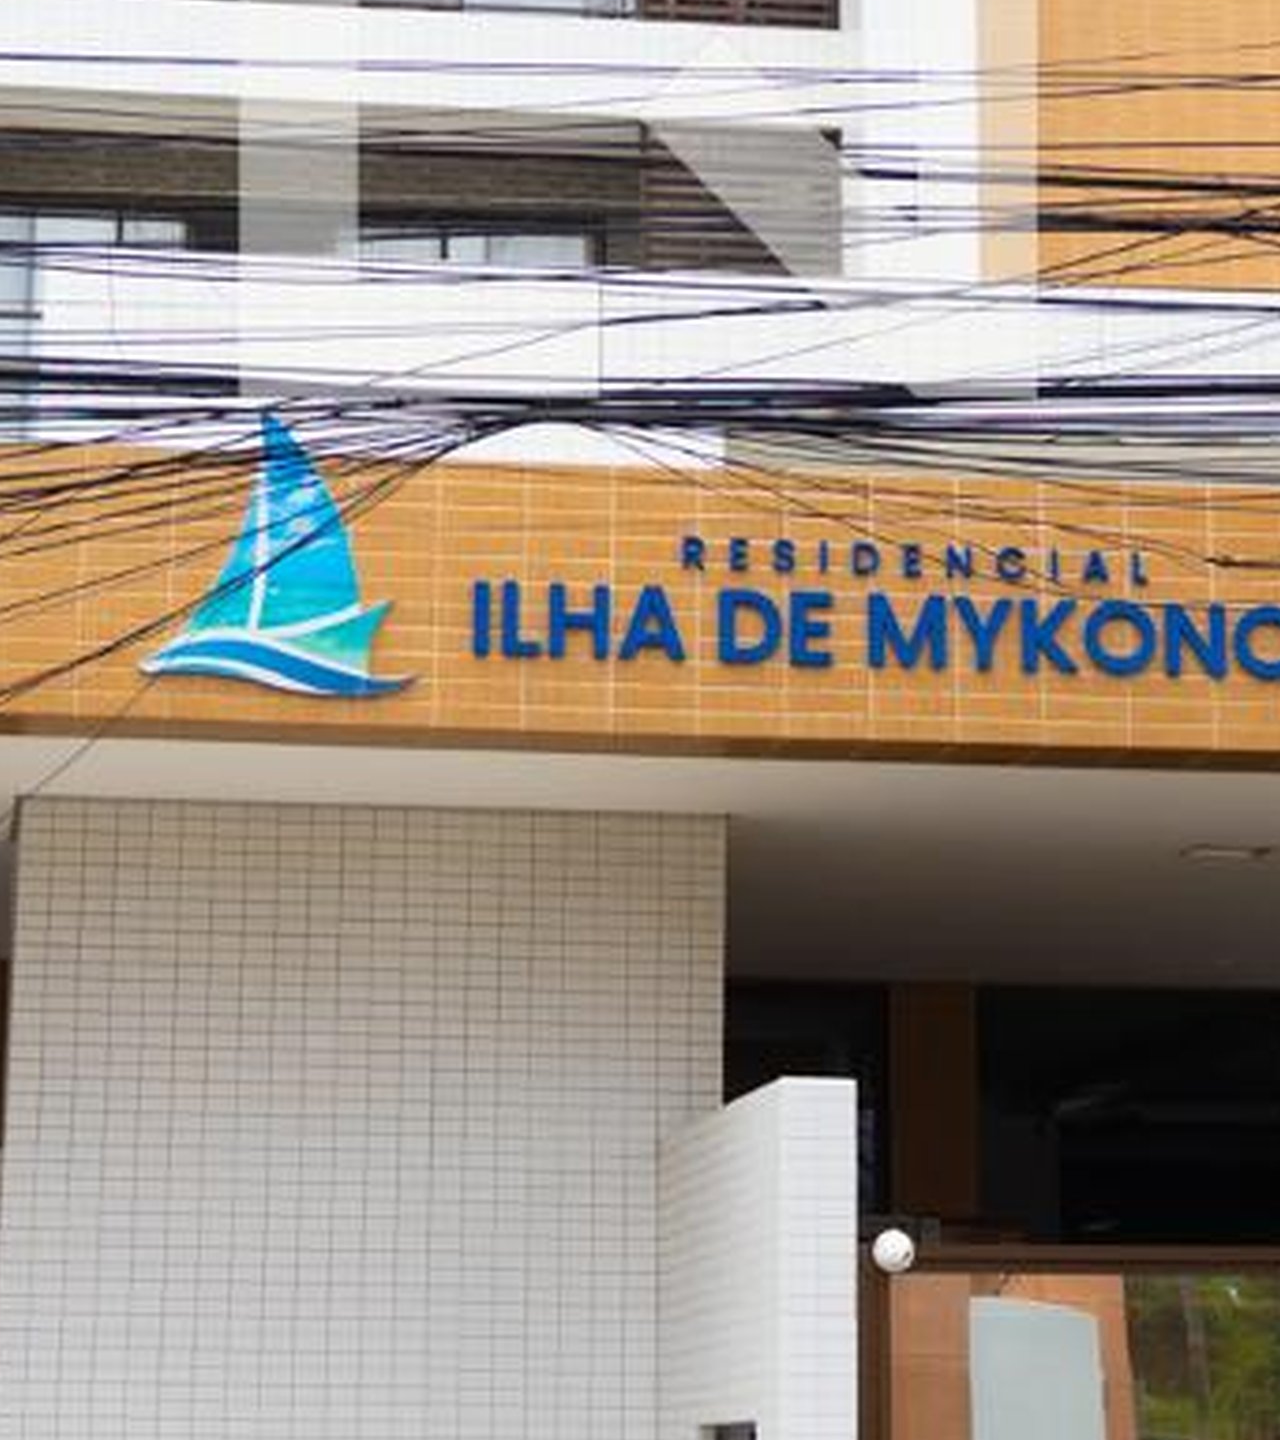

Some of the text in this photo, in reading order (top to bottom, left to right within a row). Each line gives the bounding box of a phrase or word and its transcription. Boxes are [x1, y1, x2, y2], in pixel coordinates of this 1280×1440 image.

[680, 536, 1149, 587] RESIDENCIAL
[470, 579, 686, 661] ILHA
[716, 587, 835, 668] DE
